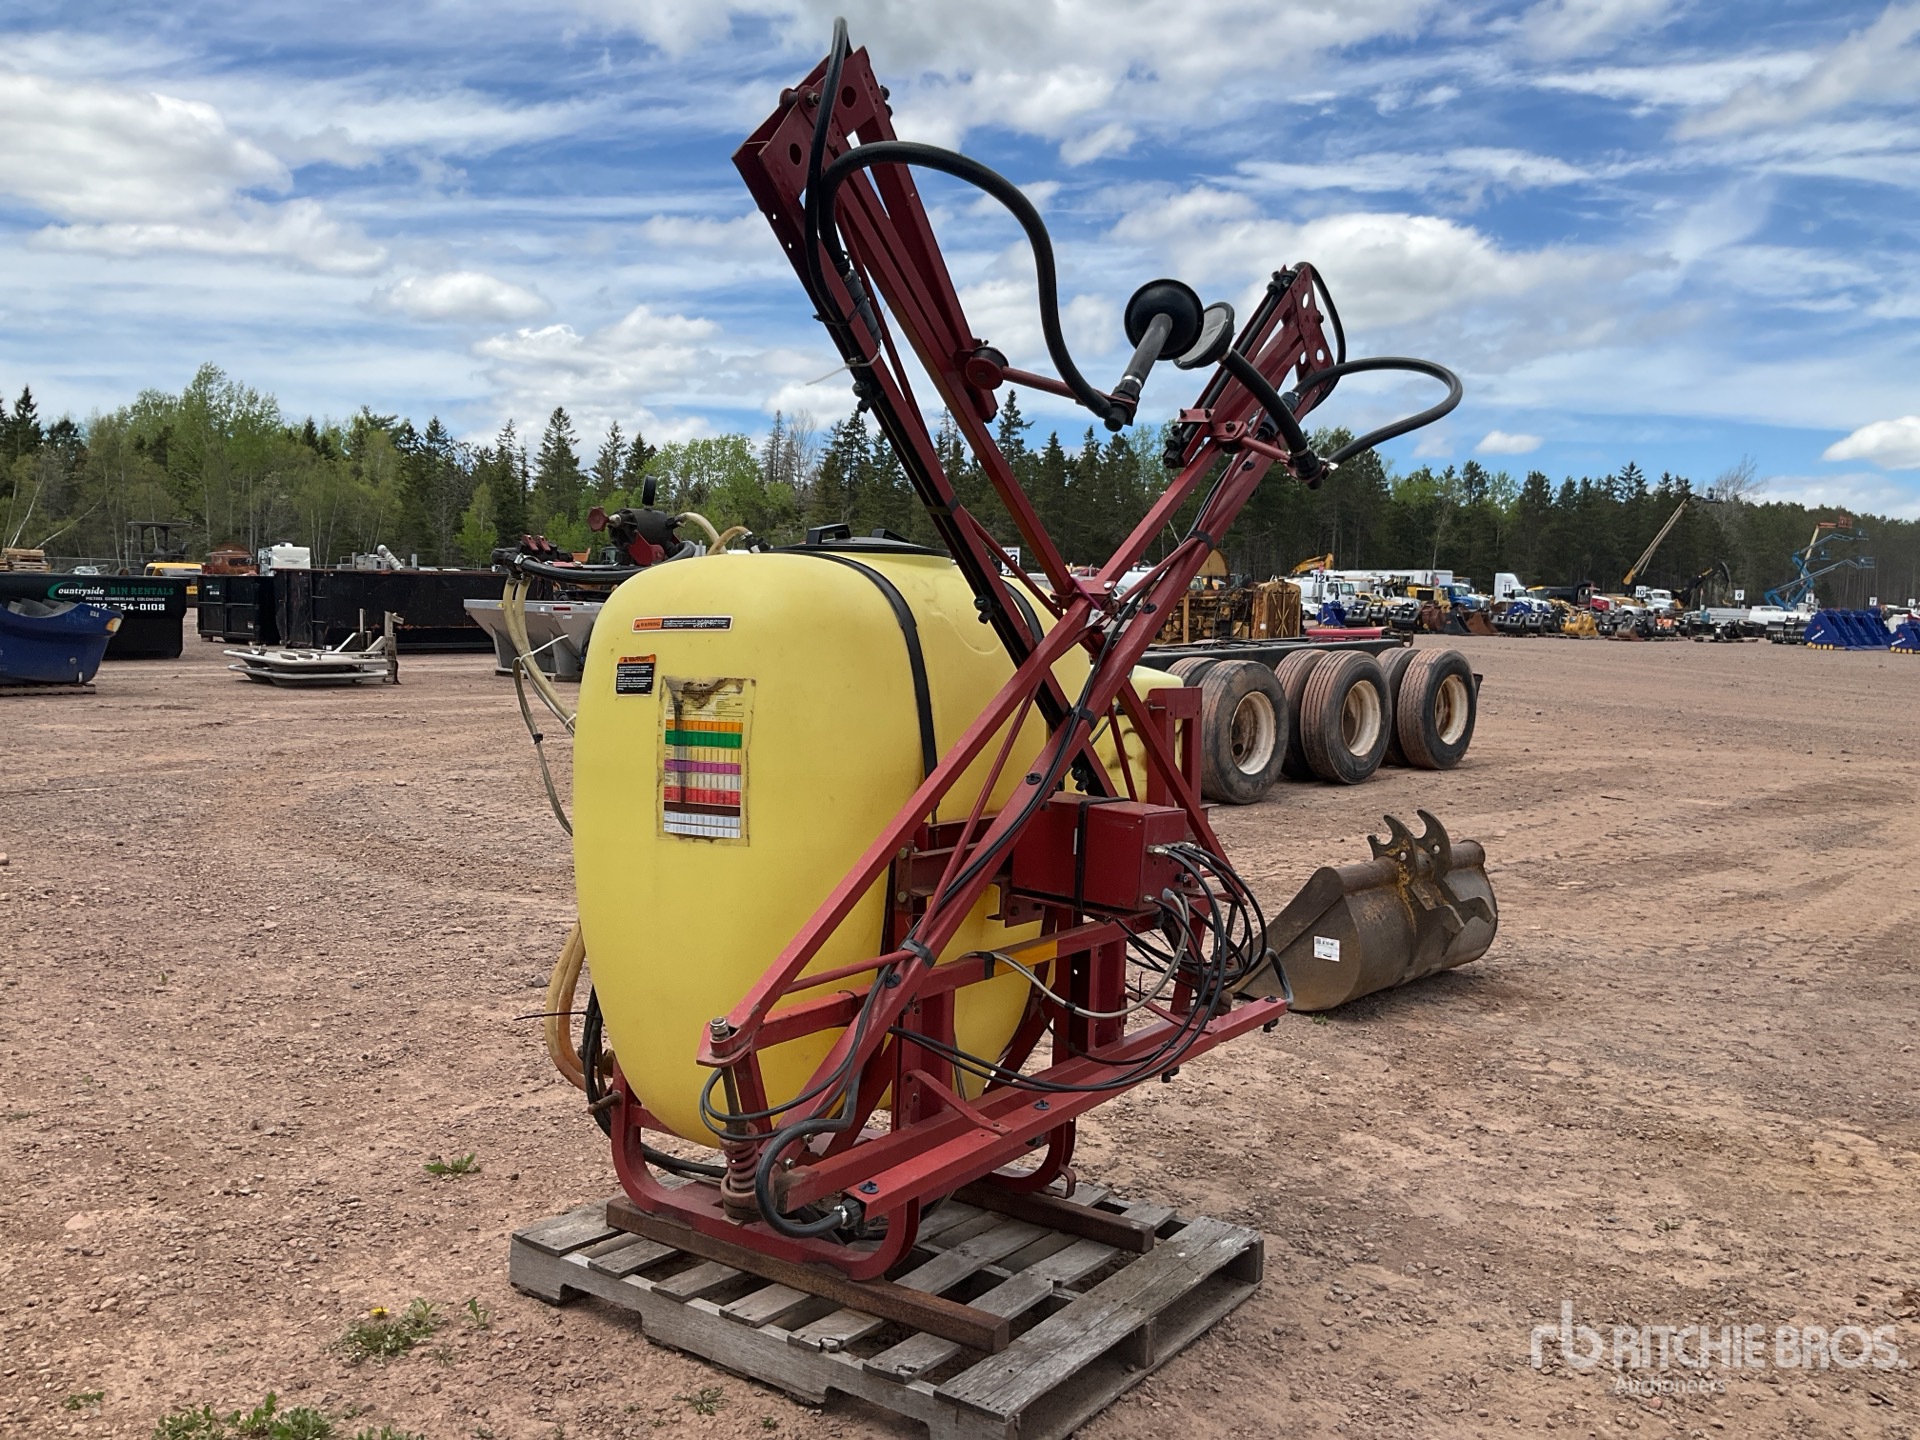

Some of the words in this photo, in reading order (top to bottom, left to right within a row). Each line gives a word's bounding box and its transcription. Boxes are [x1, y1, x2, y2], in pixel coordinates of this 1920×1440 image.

[1314, 574, 1325, 584] 12
[110, 587, 128, 595] BIN
[131, 587, 174, 595] RENTALS
[1503, 584, 1511, 592] 11
[1637, 589, 1645, 597] 10
[1736, 592, 1743, 600] 9
[86, 603, 166, 611] 02-54-0108
